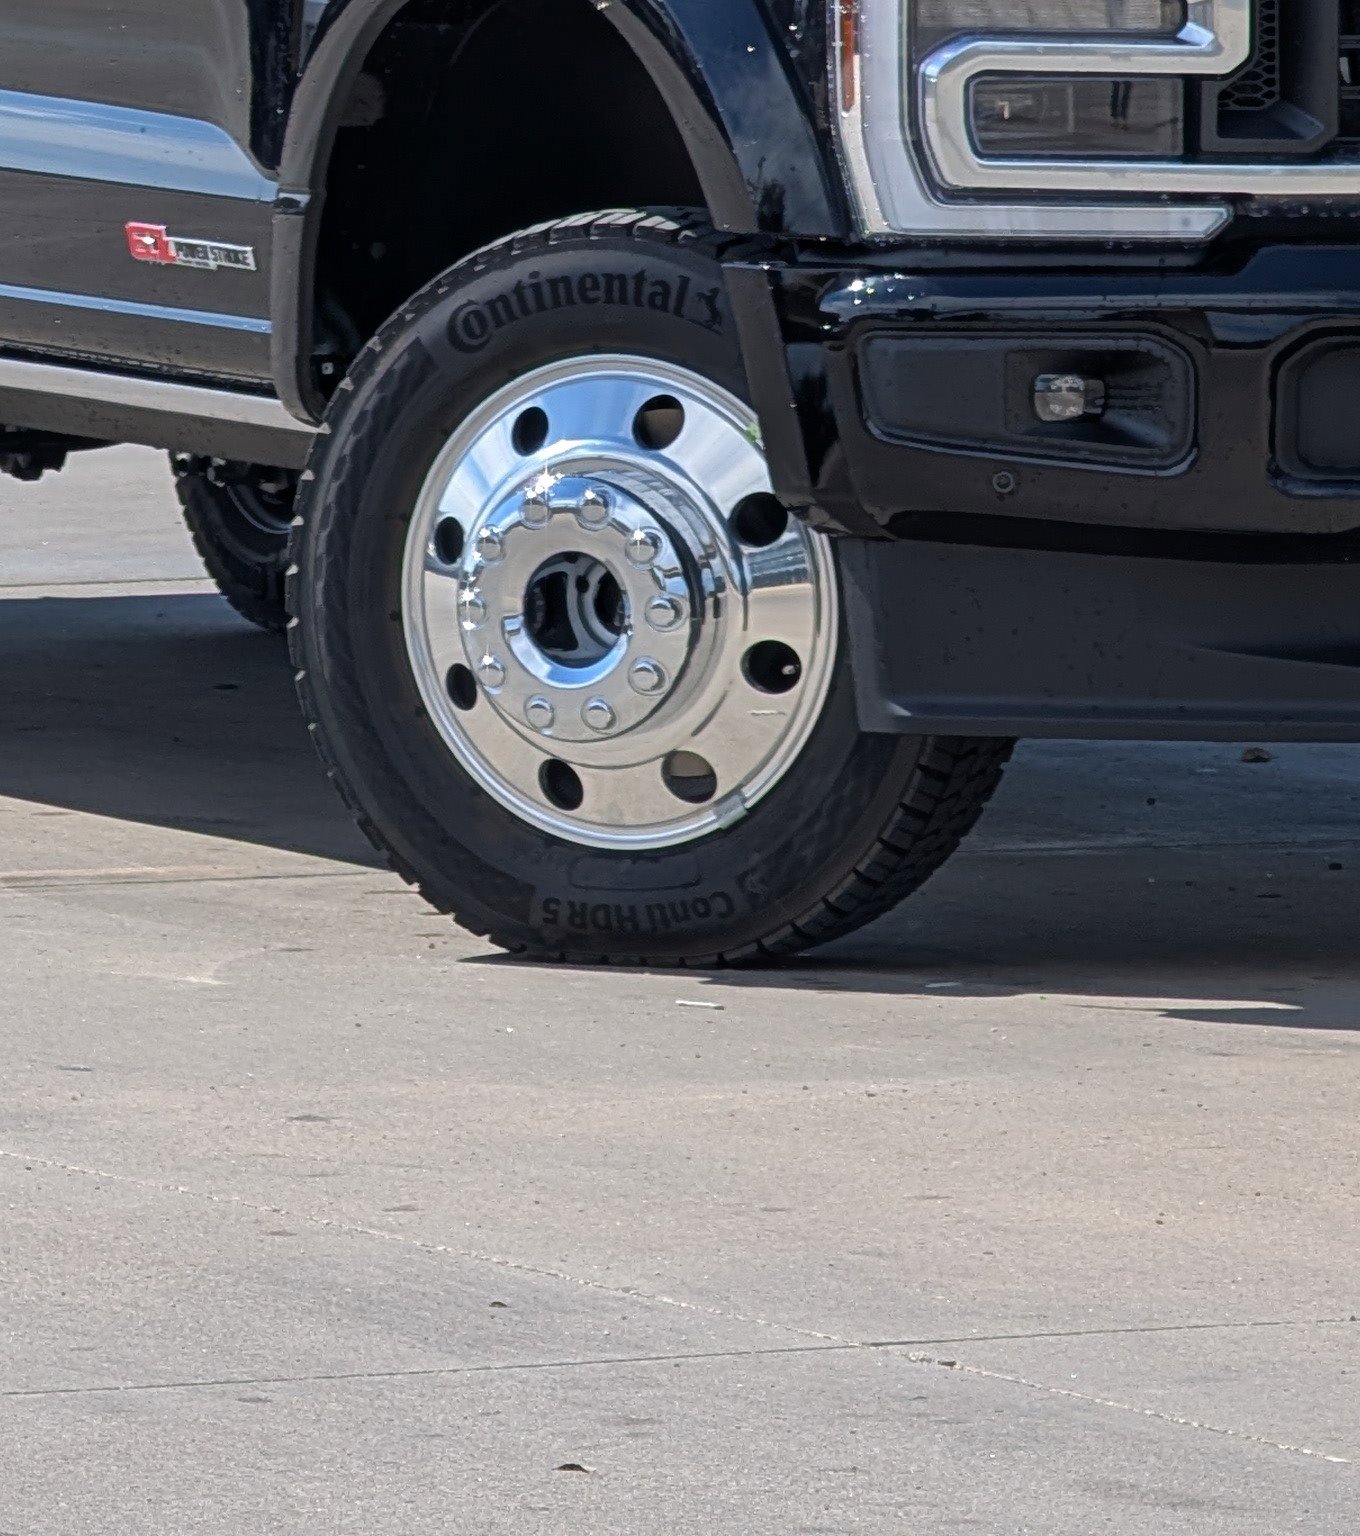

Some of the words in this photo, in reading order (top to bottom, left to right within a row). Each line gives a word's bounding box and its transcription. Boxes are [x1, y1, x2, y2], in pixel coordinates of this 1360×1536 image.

[446, 268, 691, 353] Continental
[542, 896, 562, 925] 5
[566, 899, 639, 932] HDR
